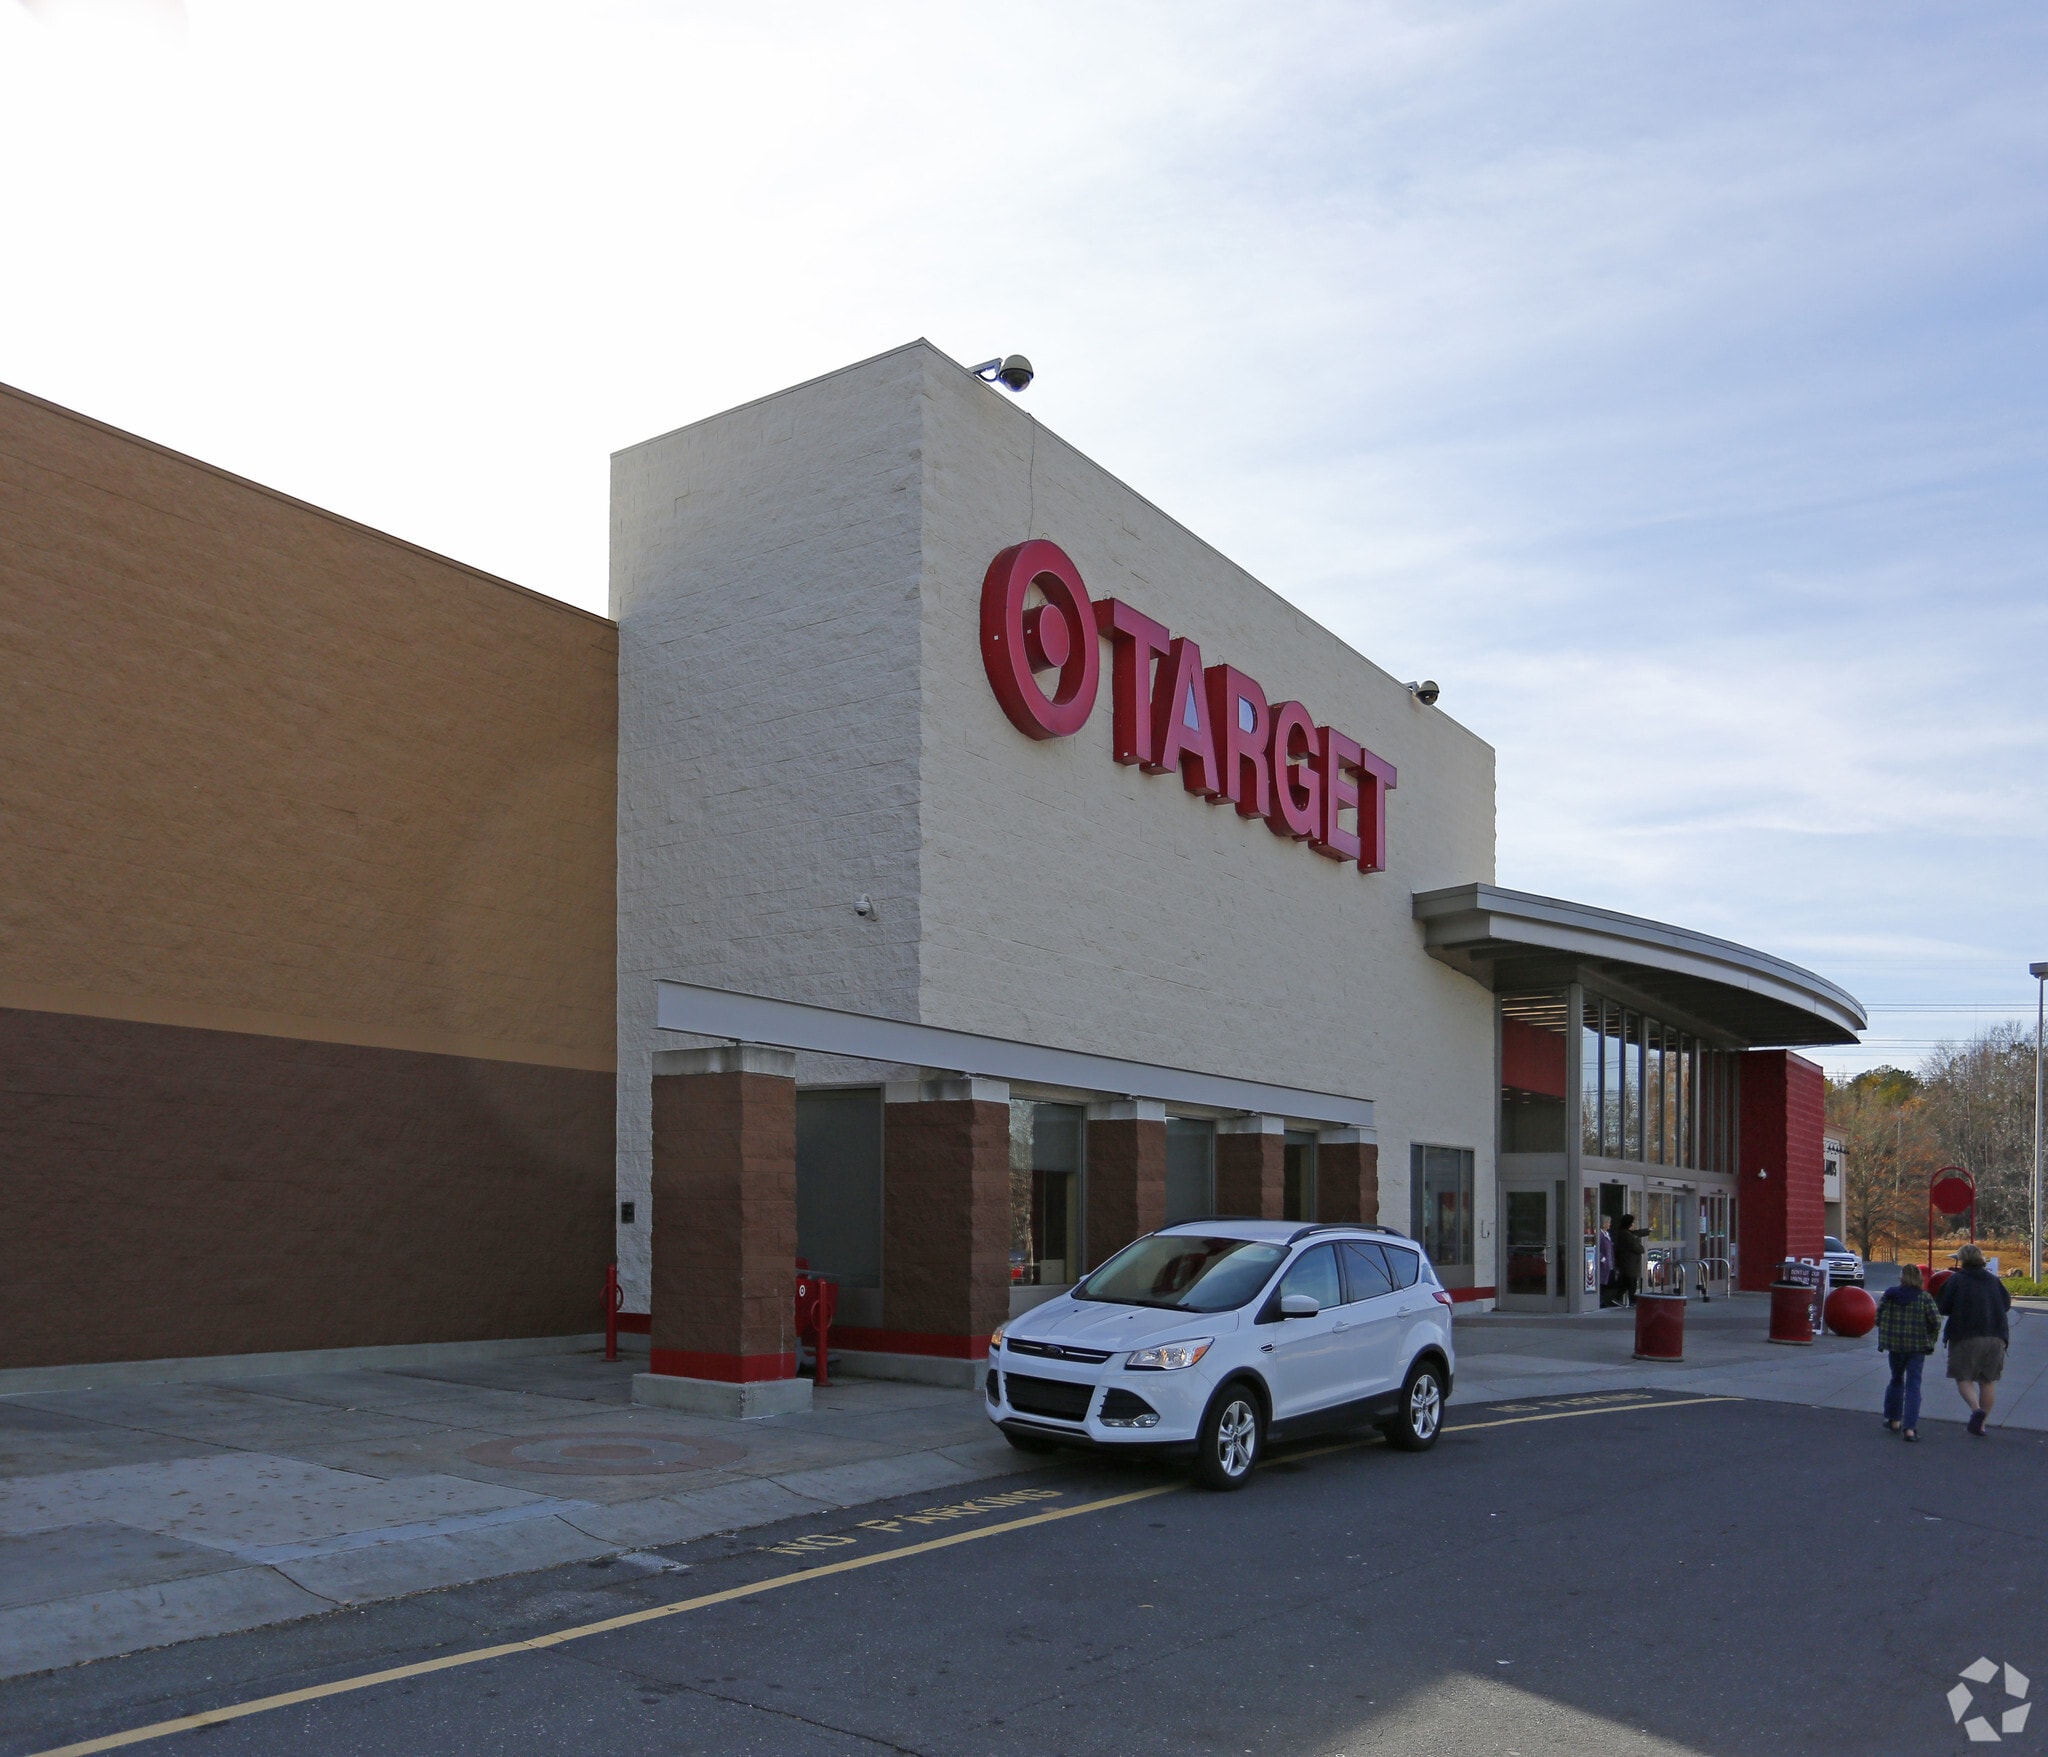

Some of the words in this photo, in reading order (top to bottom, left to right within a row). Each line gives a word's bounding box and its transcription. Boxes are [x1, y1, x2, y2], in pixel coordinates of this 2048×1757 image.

[1092, 597, 1397, 873] TARGET
[756, 1534, 857, 1556] NO
[856, 1489, 1063, 1533] PARKING
